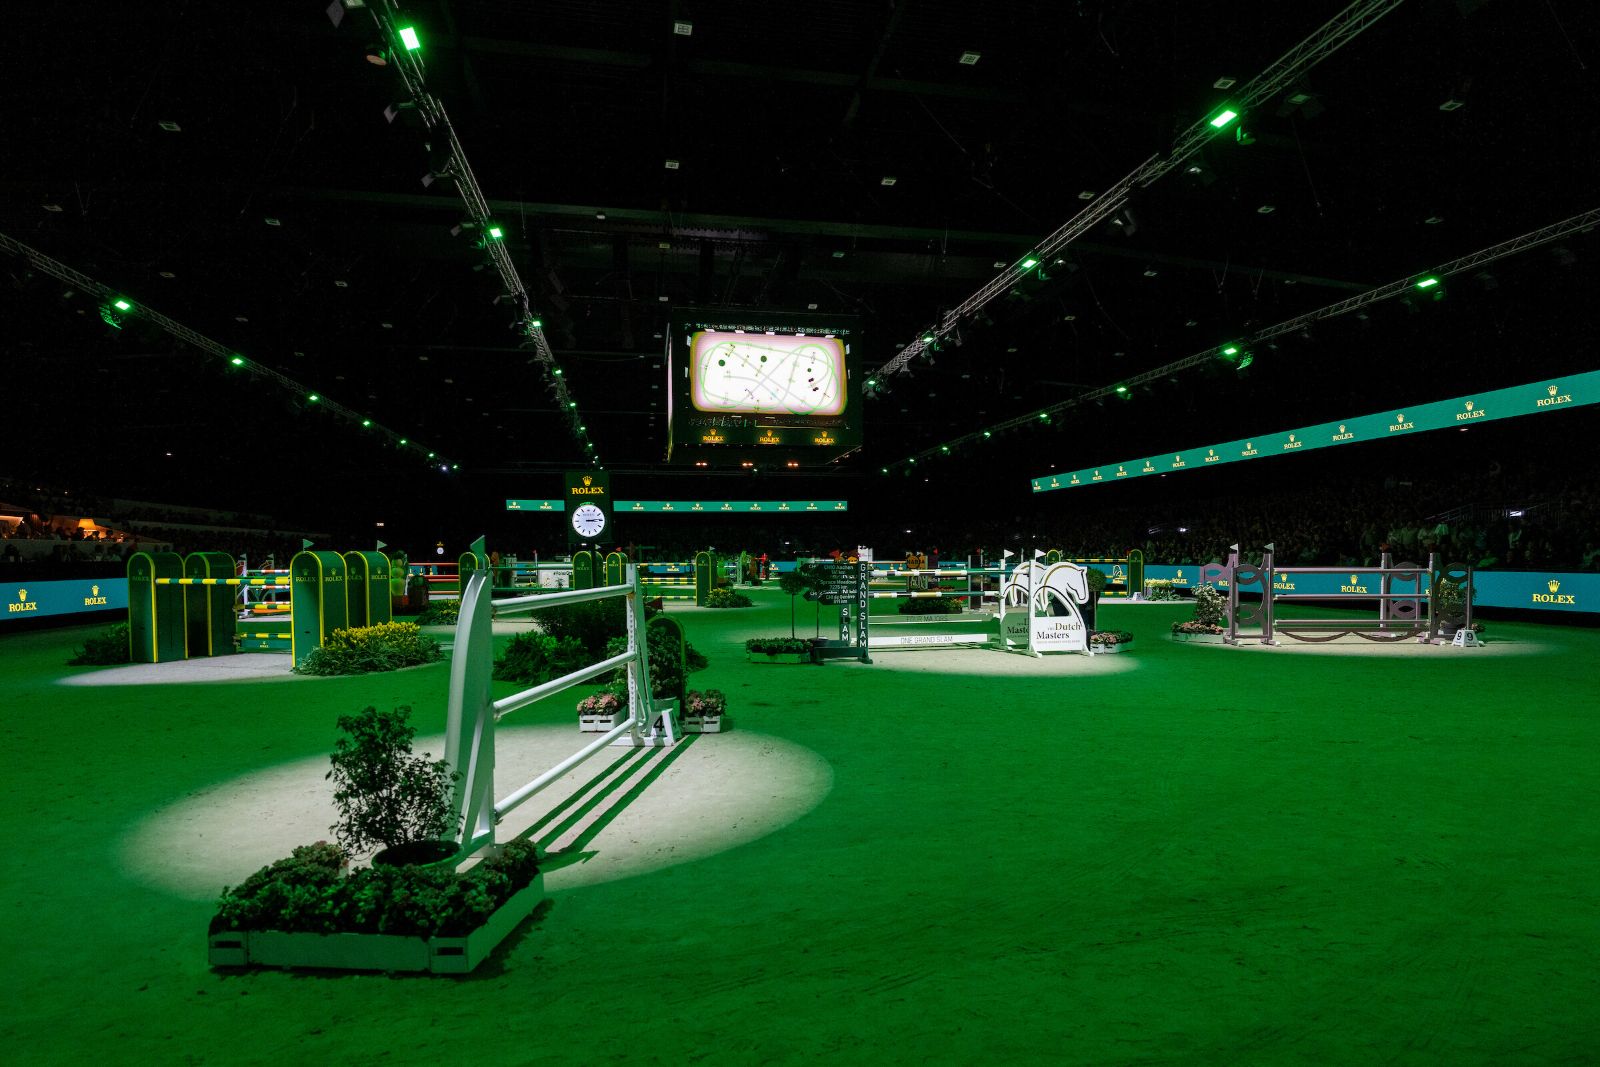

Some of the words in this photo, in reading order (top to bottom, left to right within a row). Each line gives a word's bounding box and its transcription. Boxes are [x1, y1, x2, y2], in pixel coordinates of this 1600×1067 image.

[1537, 395, 1572, 407] ROLEX
[1456, 410, 1485, 420] ROLEX
[1390, 422, 1414, 432] ROLEX
[1333, 433, 1354, 441] ROLEX
[1284, 441, 1302, 449] ROLEX
[572, 487, 604, 495] ROLEX
[1273, 582, 1295, 590] ROLEX
[1341, 585, 1367, 594] ROLEX
[85, 596, 107, 606] ROLEX
[1533, 593, 1576, 604] ROLEX
[9, 602, 37, 612] ROLEX
[1007, 626, 1029, 634] Maste
[1055, 622, 1081, 631] Dutch
[1036, 631, 1070, 640] Masters
[1457, 631, 1462, 641] 9
[1467, 632, 1474, 641] 9
[653, 714, 665, 732] 4
